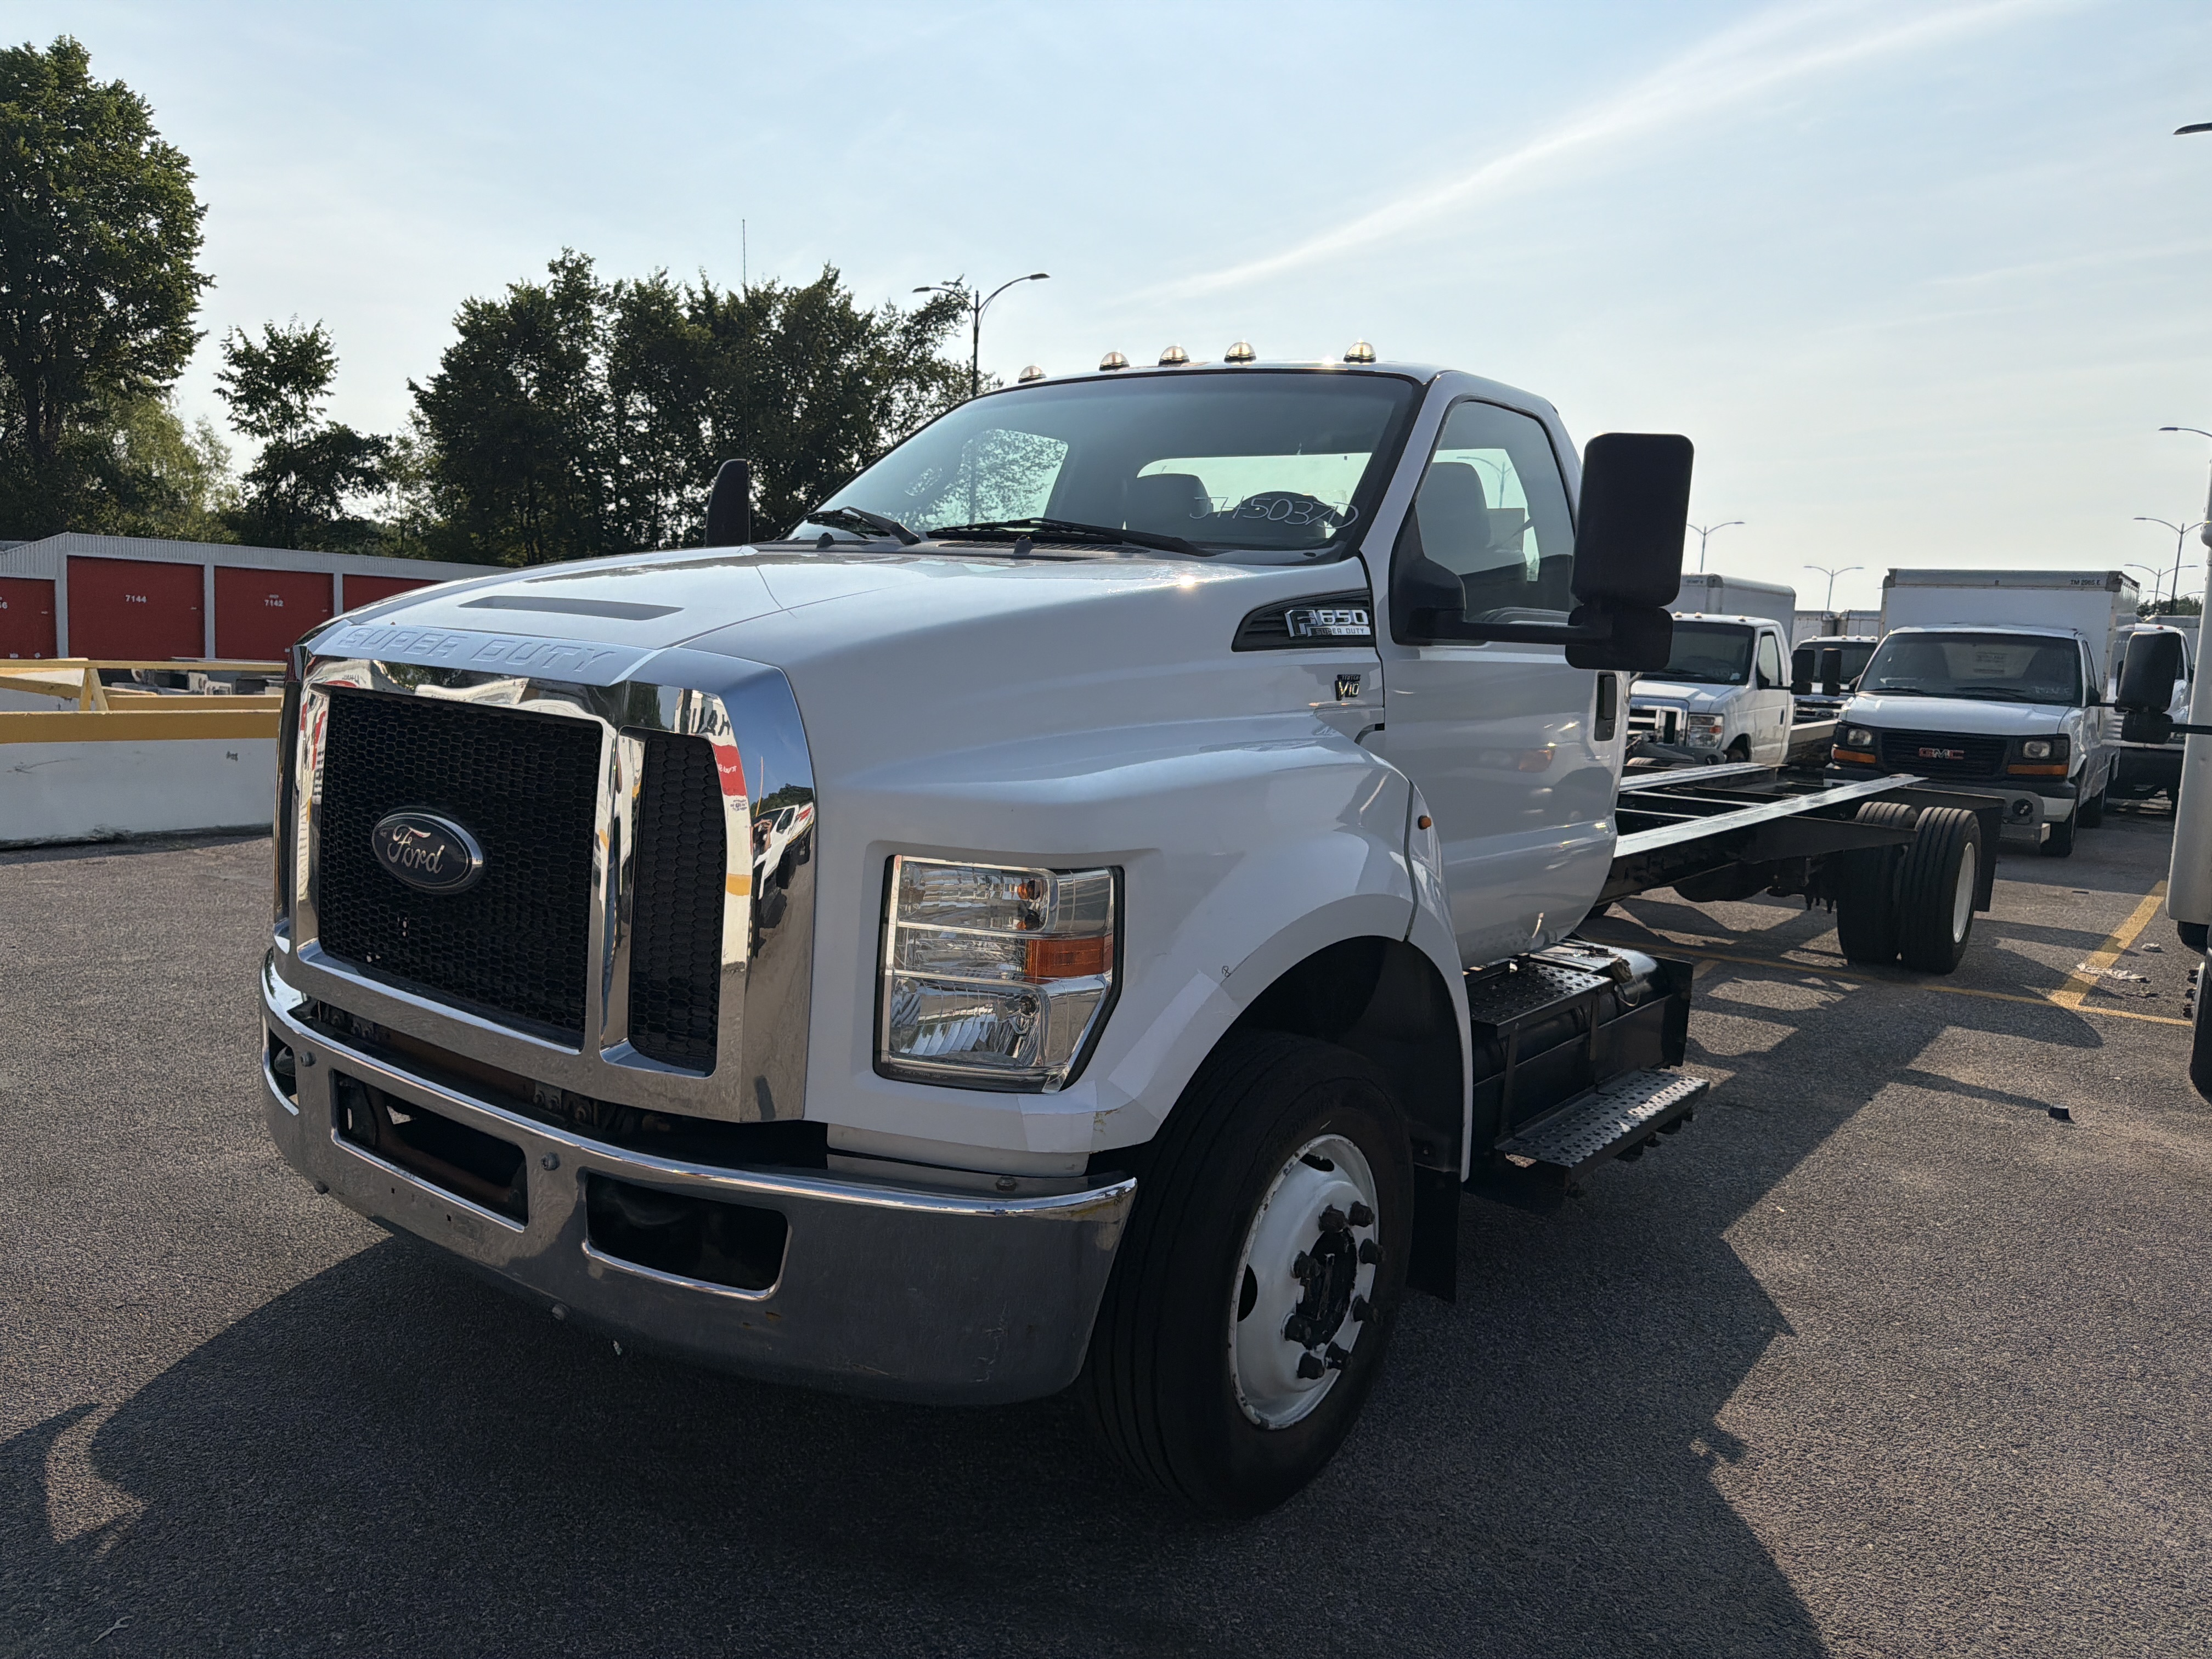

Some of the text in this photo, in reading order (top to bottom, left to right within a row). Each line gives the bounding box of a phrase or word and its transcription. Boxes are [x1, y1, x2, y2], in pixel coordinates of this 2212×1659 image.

[125, 594, 146, 603] 7144
[337, 628, 616, 672] SUPER DUTY
[1337, 681, 1359, 697] V10
[1918, 747, 1965, 760] GMC
[387, 824, 445, 873] Ford
